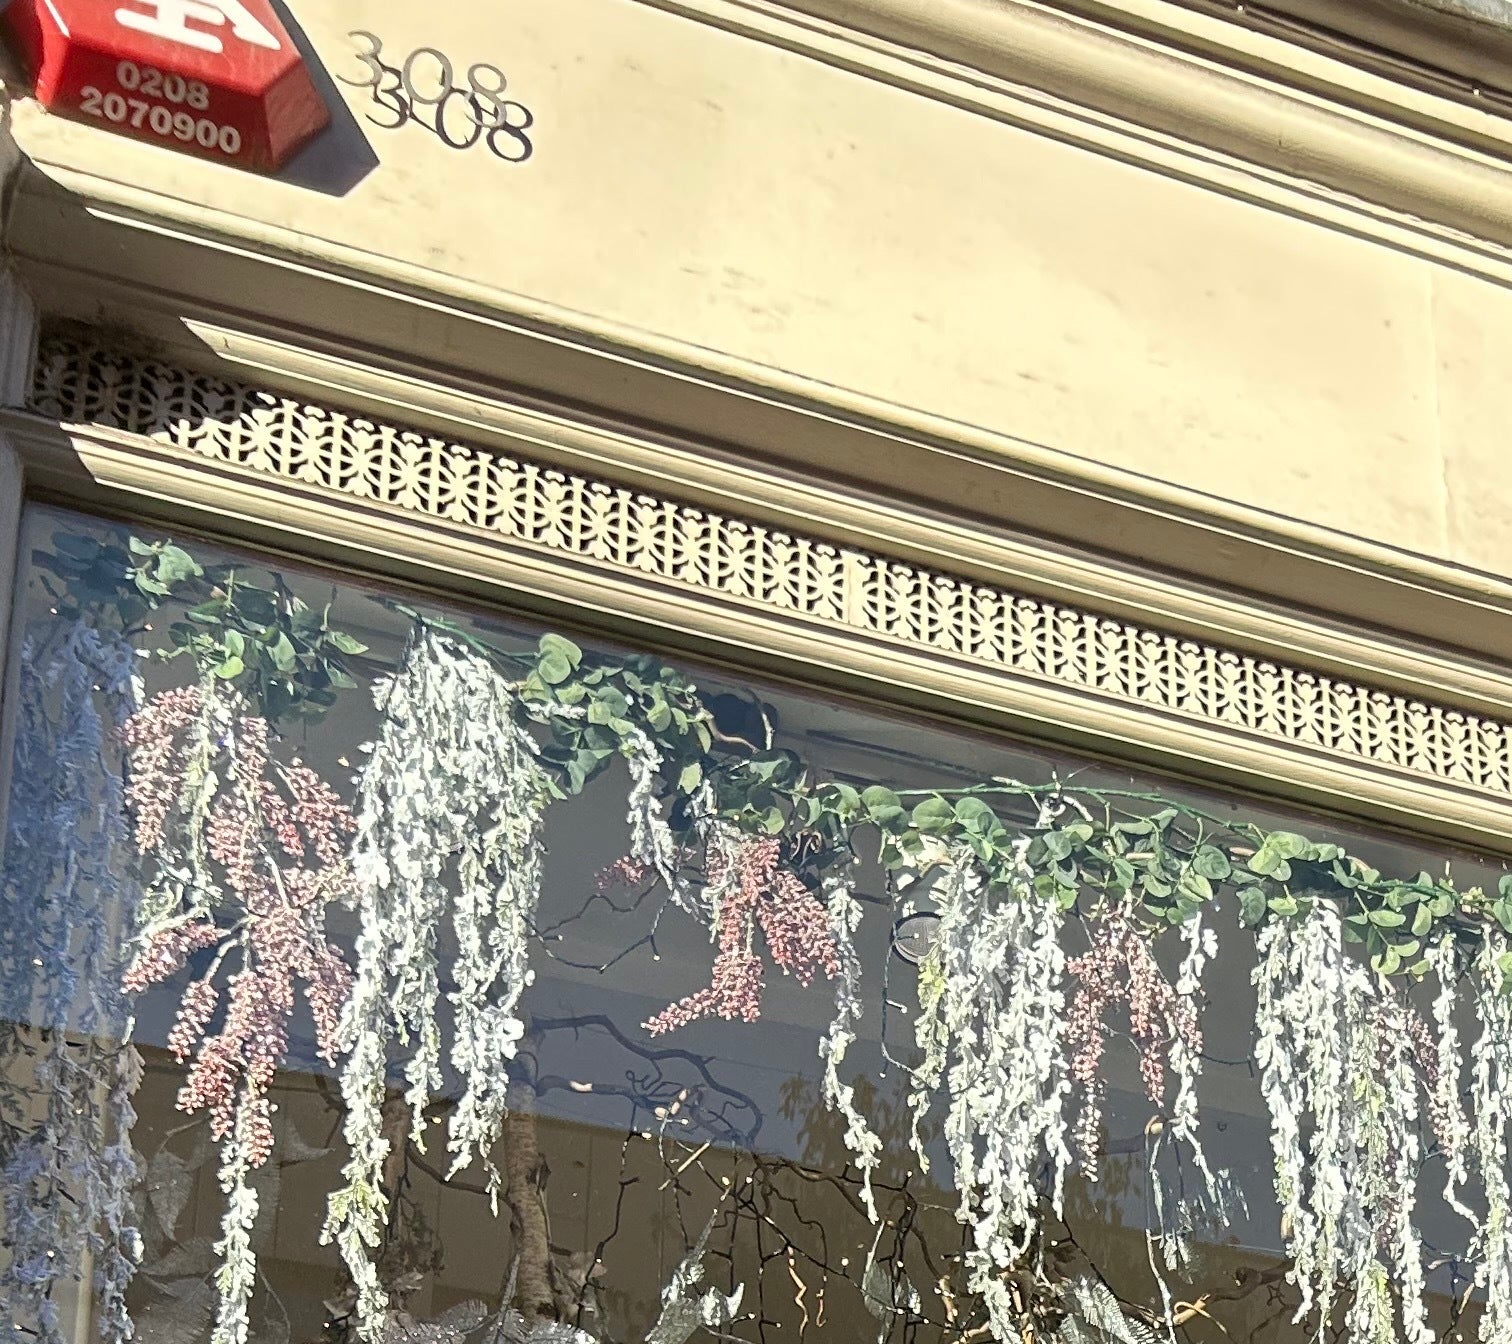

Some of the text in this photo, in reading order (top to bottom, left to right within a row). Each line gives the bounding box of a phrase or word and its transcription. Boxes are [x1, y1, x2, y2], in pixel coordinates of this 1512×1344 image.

[116, 60, 210, 110] 0208
[335, 29, 508, 129] 308
[79, 85, 242, 155] 2070900
